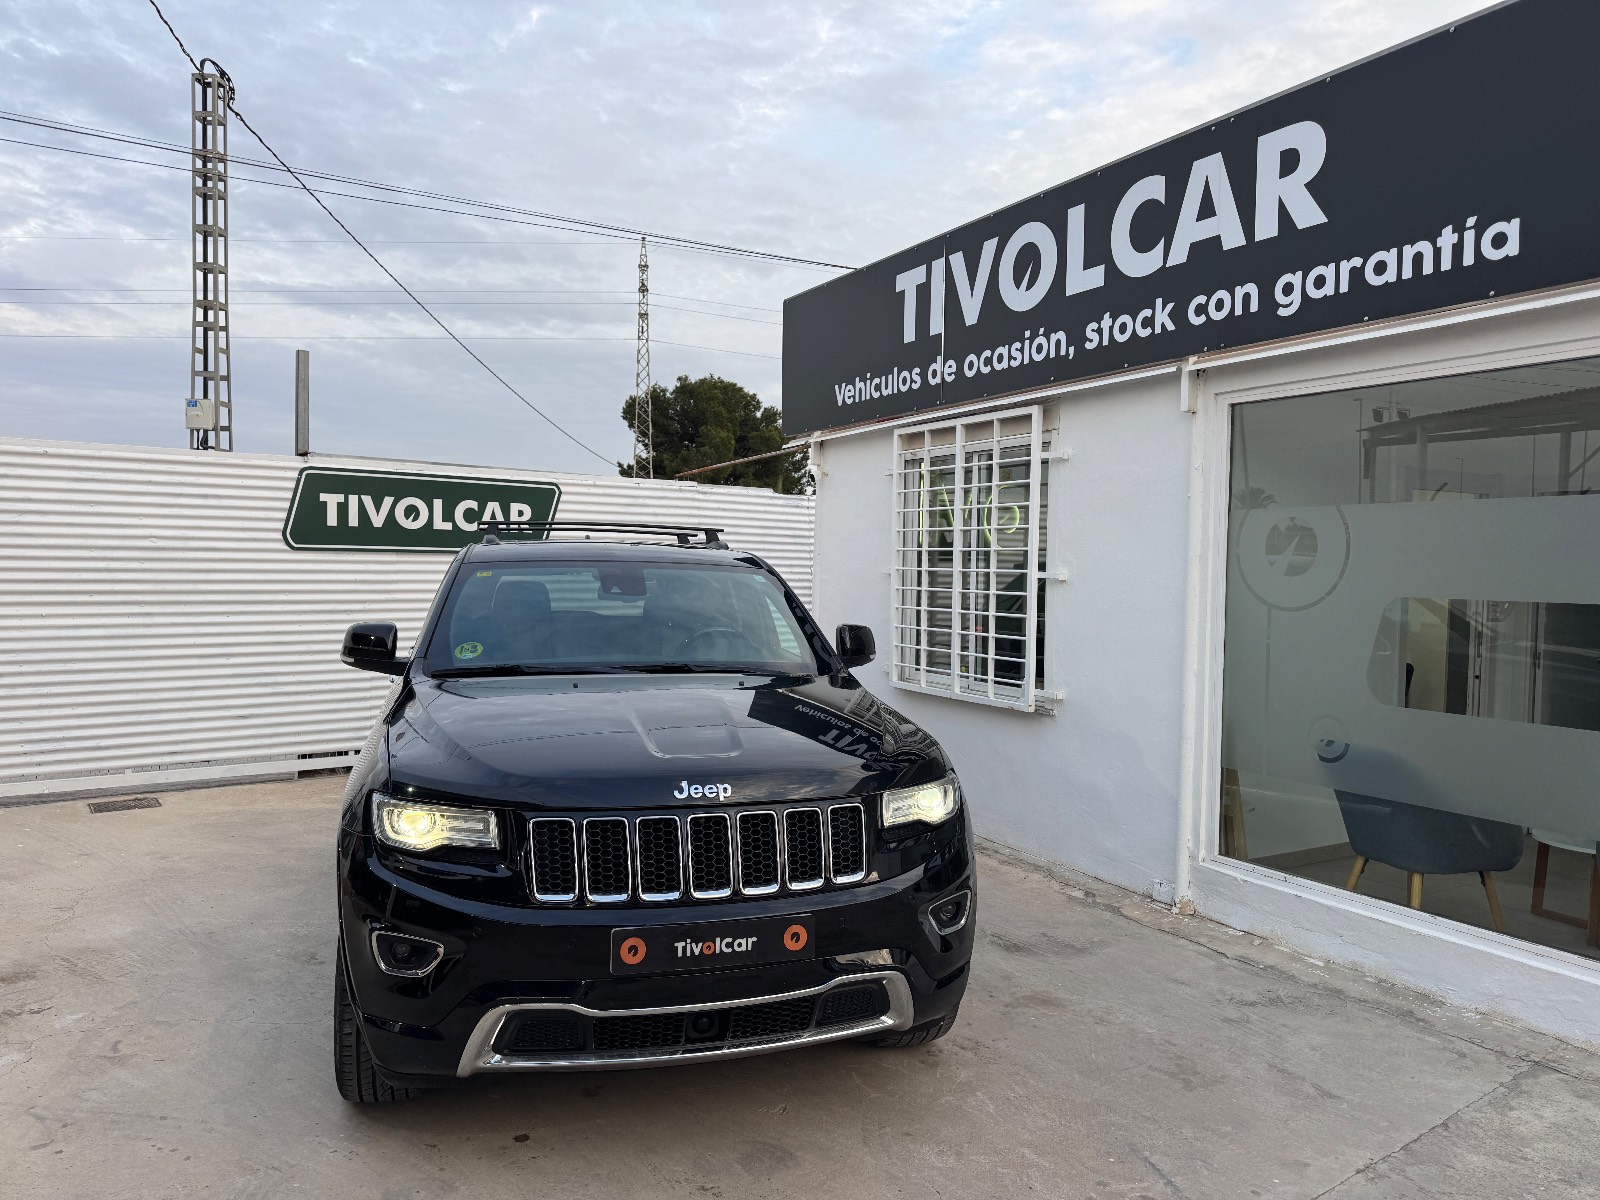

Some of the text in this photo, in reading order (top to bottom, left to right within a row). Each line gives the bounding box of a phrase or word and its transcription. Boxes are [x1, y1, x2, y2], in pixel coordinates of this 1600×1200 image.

[895, 120, 1328, 343] TIVOLCAR
[928, 356, 957, 386] de
[964, 327, 1075, 378] ocasión,
[1084, 297, 1175, 349] stock
[1187, 282, 1259, 326] con
[1274, 216, 1521, 316] garantía
[319, 492, 533, 534] TIVOLCAR
[673, 780, 732, 801] Jeep
